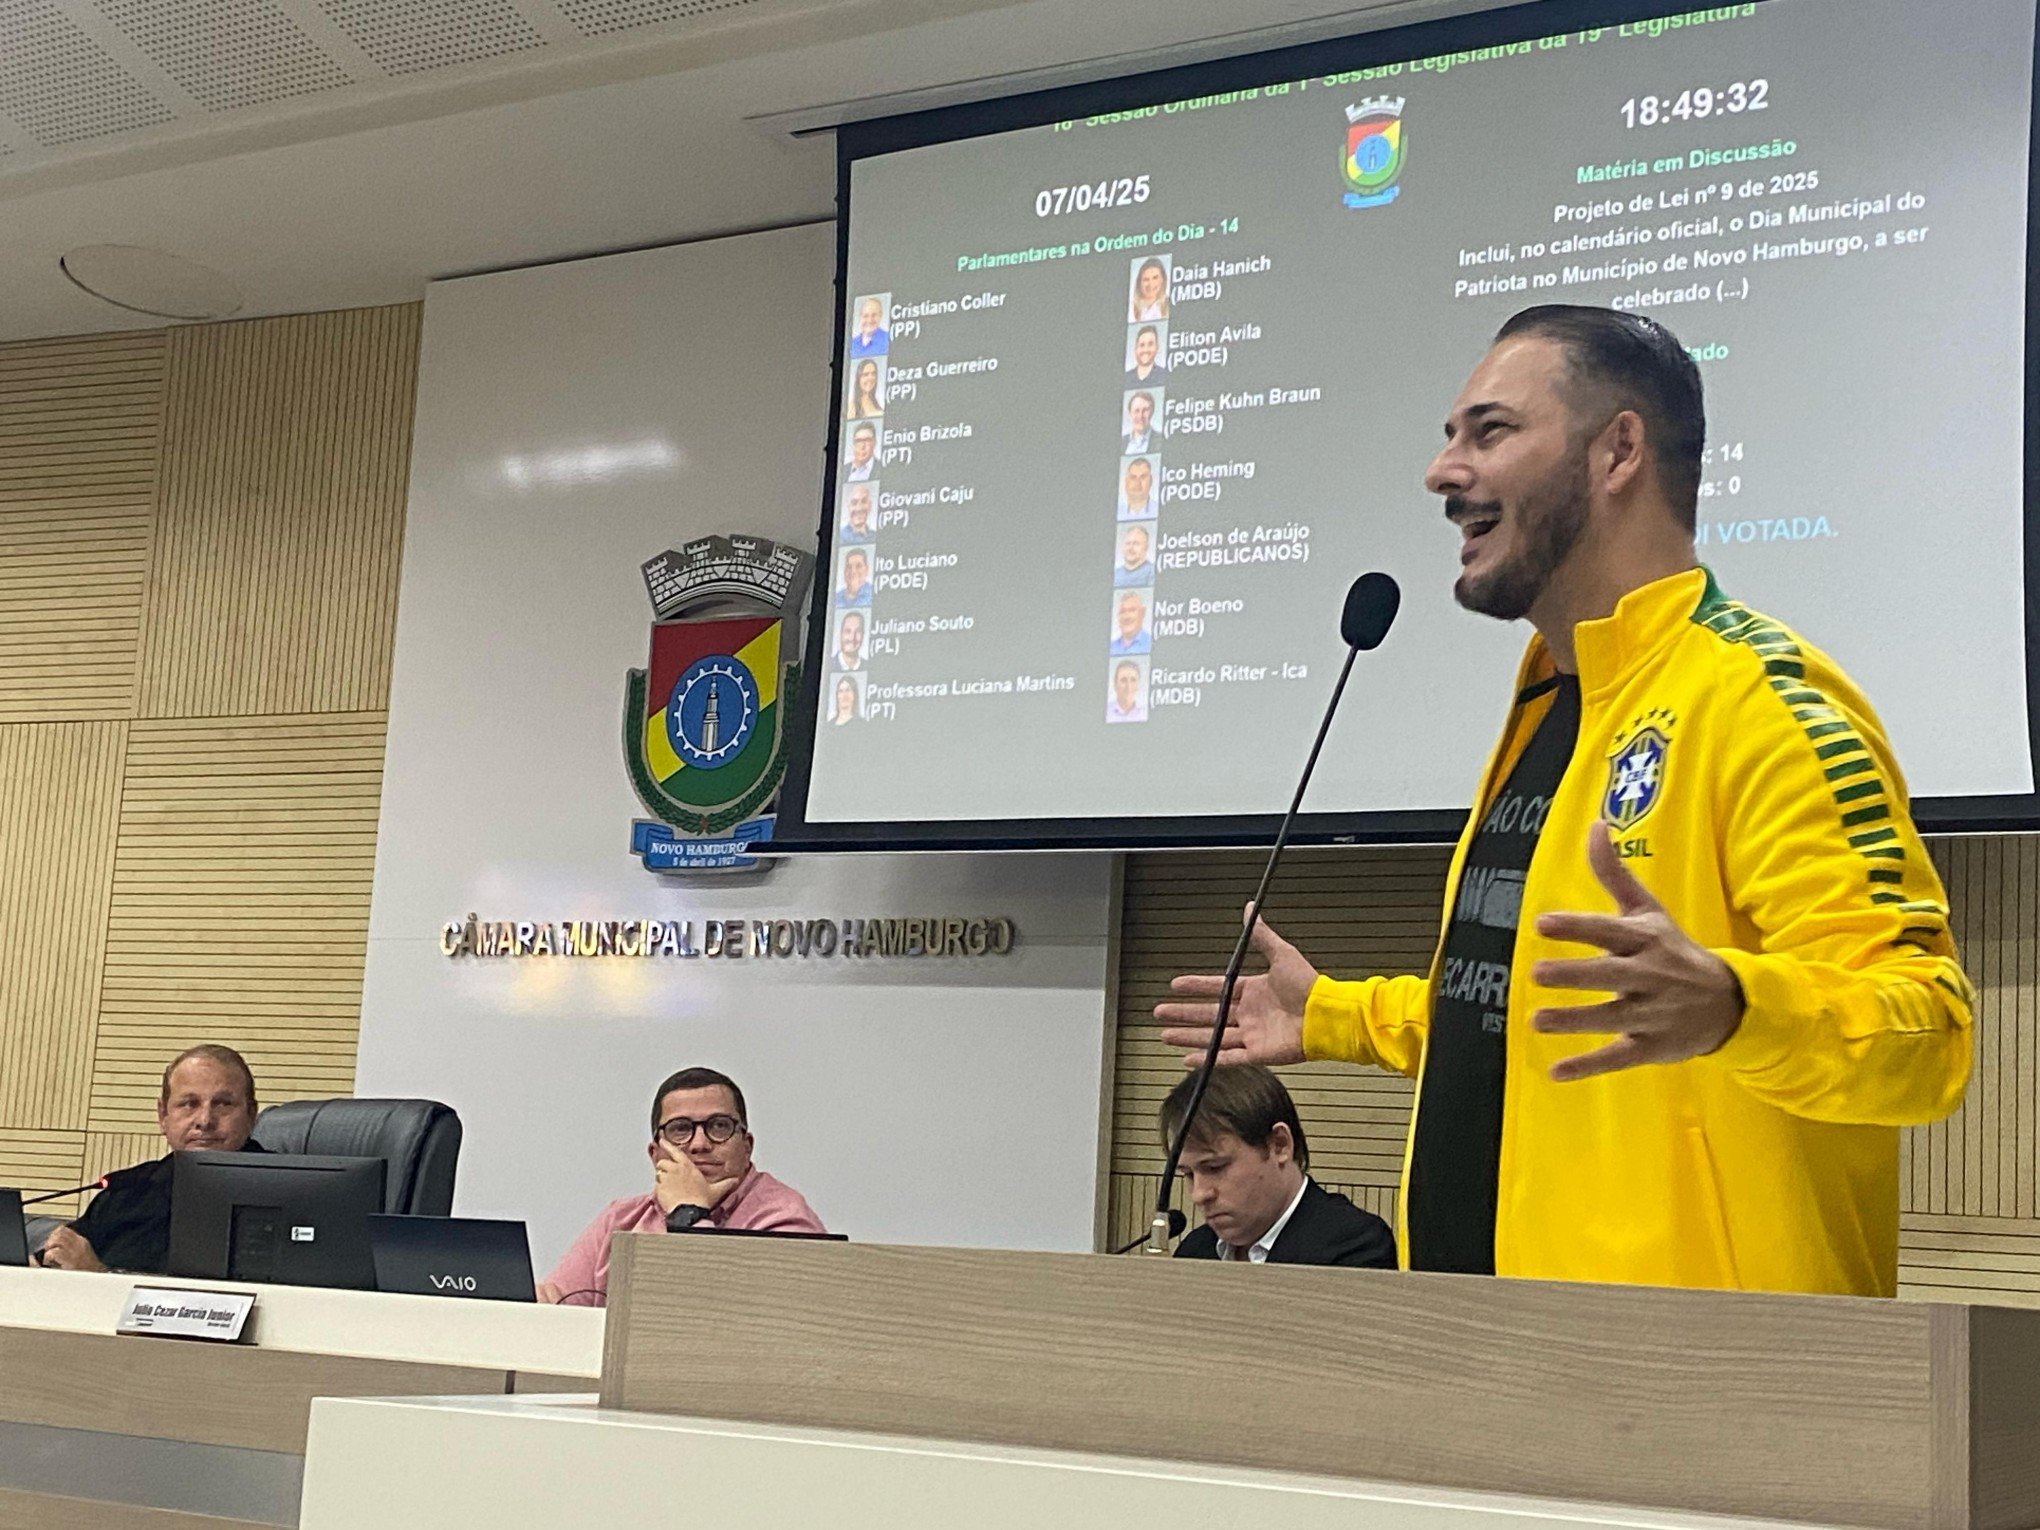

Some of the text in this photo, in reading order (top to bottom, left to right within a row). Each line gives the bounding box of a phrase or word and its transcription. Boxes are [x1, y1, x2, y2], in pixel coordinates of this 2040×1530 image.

[1619, 78, 1769, 129] 18:49:32
[1576, 139, 1797, 185] Matéria em Discussão
[1035, 175, 1150, 218] 07/04/25
[1554, 196, 1624, 224] Projeto
[1628, 192, 1653, 213] de
[1659, 186, 1690, 209] Lei
[1721, 182, 1733, 200] 9
[1738, 178, 1764, 198] de
[1769, 171, 1819, 193] 2025
[1458, 191, 1926, 268] Inclui, no calendário oficial, o Dia Municipal do
[957, 241, 1067, 273] Parlamentares
[1070, 239, 1090, 256] na
[1093, 230, 1148, 254] Ordem
[1152, 226, 1173, 245] do
[1176, 222, 1204, 241] Dia
[1219, 217, 1238, 235] 14
[1172, 255, 1272, 284] Daia Hanich
[1454, 224, 1928, 298] Patriota no Município de Novo Hamburgo, a ser
[1171, 282, 1222, 305] (MDB)
[1611, 278, 1749, 311] celebrado (...)
[891, 292, 1007, 321] Cristiano Coller
[890, 321, 921, 341] (PP)
[1169, 323, 1262, 348] Eliton Avila
[887, 356, 998, 383] Deza Guerreiro
[1167, 347, 1228, 371] (PODE)
[886, 382, 916, 402] (PP)
[1165, 386, 1321, 418] Felipe Kuhn Braun
[883, 423, 973, 445] Enio Brizola
[1164, 415, 1224, 439] (PSDB)
[882, 446, 912, 466] (PT)
[1720, 442, 1744, 462] 14
[1161, 459, 1256, 481] Ico Heming
[1160, 482, 1222, 504] (PODE)
[1729, 475, 1741, 494] 0
[880, 485, 974, 509] Giovani Caju
[878, 510, 909, 529] (PP)
[1718, 515, 1839, 544] VOTADA.
[1157, 522, 1310, 551] Joelson de Araújo
[875, 550, 958, 571] Ito Luciano
[1156, 544, 1310, 572] (REPUBLICANOS)
[874, 571, 928, 591] (PODE)
[1155, 597, 1243, 617] Nor Boeno
[870, 615, 974, 635] Juliano Souto
[1154, 618, 1204, 640] (MDB)
[869, 637, 900, 656] (PL)
[1152, 665, 1215, 686] Ricardo
[1220, 663, 1266, 682] Ritter
[1282, 662, 1307, 680] Ica
[867, 674, 1075, 700] Professora Luciana Martins
[1150, 687, 1201, 709] (MDB)
[866, 702, 896, 722] (PT)
[651, 842, 683, 855] NOVO
[439, 912, 1015, 958] CÂMARA MUNICIPAL DE NOVO HAMBURGO
[429, 1274, 476, 1292] VAIO
